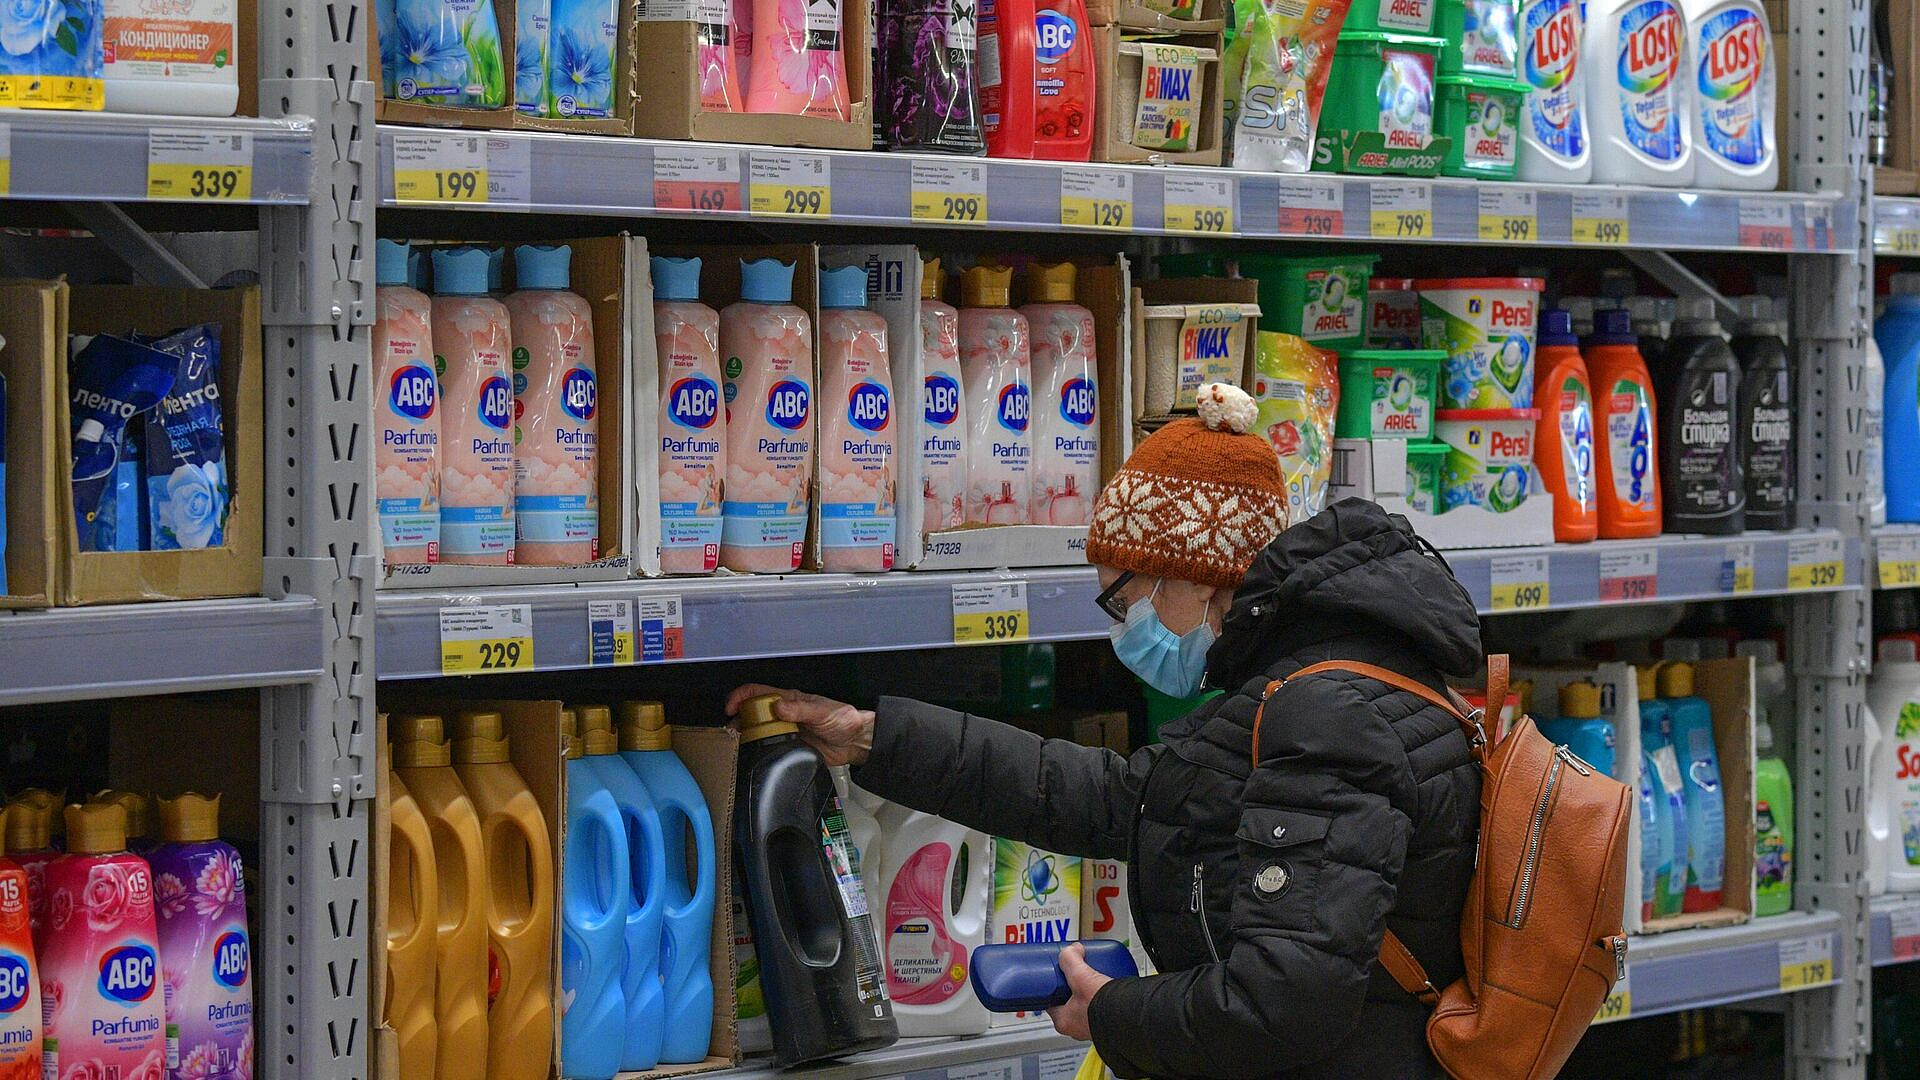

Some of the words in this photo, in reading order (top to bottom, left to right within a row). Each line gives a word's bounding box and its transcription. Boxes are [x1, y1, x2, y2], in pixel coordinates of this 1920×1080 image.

[119, 30, 210, 50] КОНДИЦИОНЕР
[1629, 18, 1679, 73] LOSK
[1156, 48, 1179, 63] ECO
[1709, 24, 1762, 80] LOSK
[1145, 66, 1193, 101] BiMAX
[1475, 140, 1504, 156] ARIEL
[191, 170, 237, 198] 339
[435, 172, 477, 198] 199
[688, 189, 726, 214] 169
[784, 190, 821, 214] 299
[944, 197, 978, 221] 299
[1092, 202, 1123, 227] 129
[1194, 210, 1225, 232] 599
[1304, 214, 1332, 235] 239
[1396, 214, 1424, 236] 799
[1502, 220, 1529, 240] 599
[1594, 223, 1621, 242] 499
[1198, 308, 1223, 324] ECO
[1314, 314, 1348, 332] ARIEL
[1491, 300, 1534, 328] Persil
[1184, 326, 1232, 361] BiMAX
[397, 377, 434, 407] ABC
[485, 388, 512, 417] ABC
[566, 379, 595, 407] ABC
[676, 389, 715, 417] ABC
[925, 386, 958, 413] ABC
[1066, 388, 1094, 414] ABC
[73, 388, 137, 419] лента
[772, 391, 807, 418] ABC
[854, 394, 887, 420] ABC
[1004, 394, 1030, 420] ABC
[1384, 414, 1417, 430] ARIEL
[384, 428, 438, 446] Parfumia
[662, 437, 719, 453] Parfumia
[758, 438, 808, 453] Parfumia
[843, 440, 892, 455] Parfumia
[1490, 429, 1529, 457] Persil
[429, 543, 437, 553] 60
[706, 544, 716, 556] 60
[794, 544, 802, 554] 60
[884, 544, 893, 555] 60
[1810, 566, 1836, 586] 329
[1514, 587, 1542, 608] 699
[984, 614, 1018, 640] 339
[480, 642, 520, 669] 229
[1, 878, 20, 900] 15
[130, 871, 148, 891] 15
[1030, 905, 1070, 917] TECHNOLOGY
[218, 942, 248, 976] ABC
[894, 958, 940, 967] ДЕЛИКАТНЫХ
[106, 956, 153, 990] ABC
[894, 975, 920, 984] ТКАНЕЙ
[901, 966, 942, 975] ШЕРСТЯНЫХ
[208, 1000, 250, 1020] Parfumia
[92, 1014, 160, 1036] Parfumia
